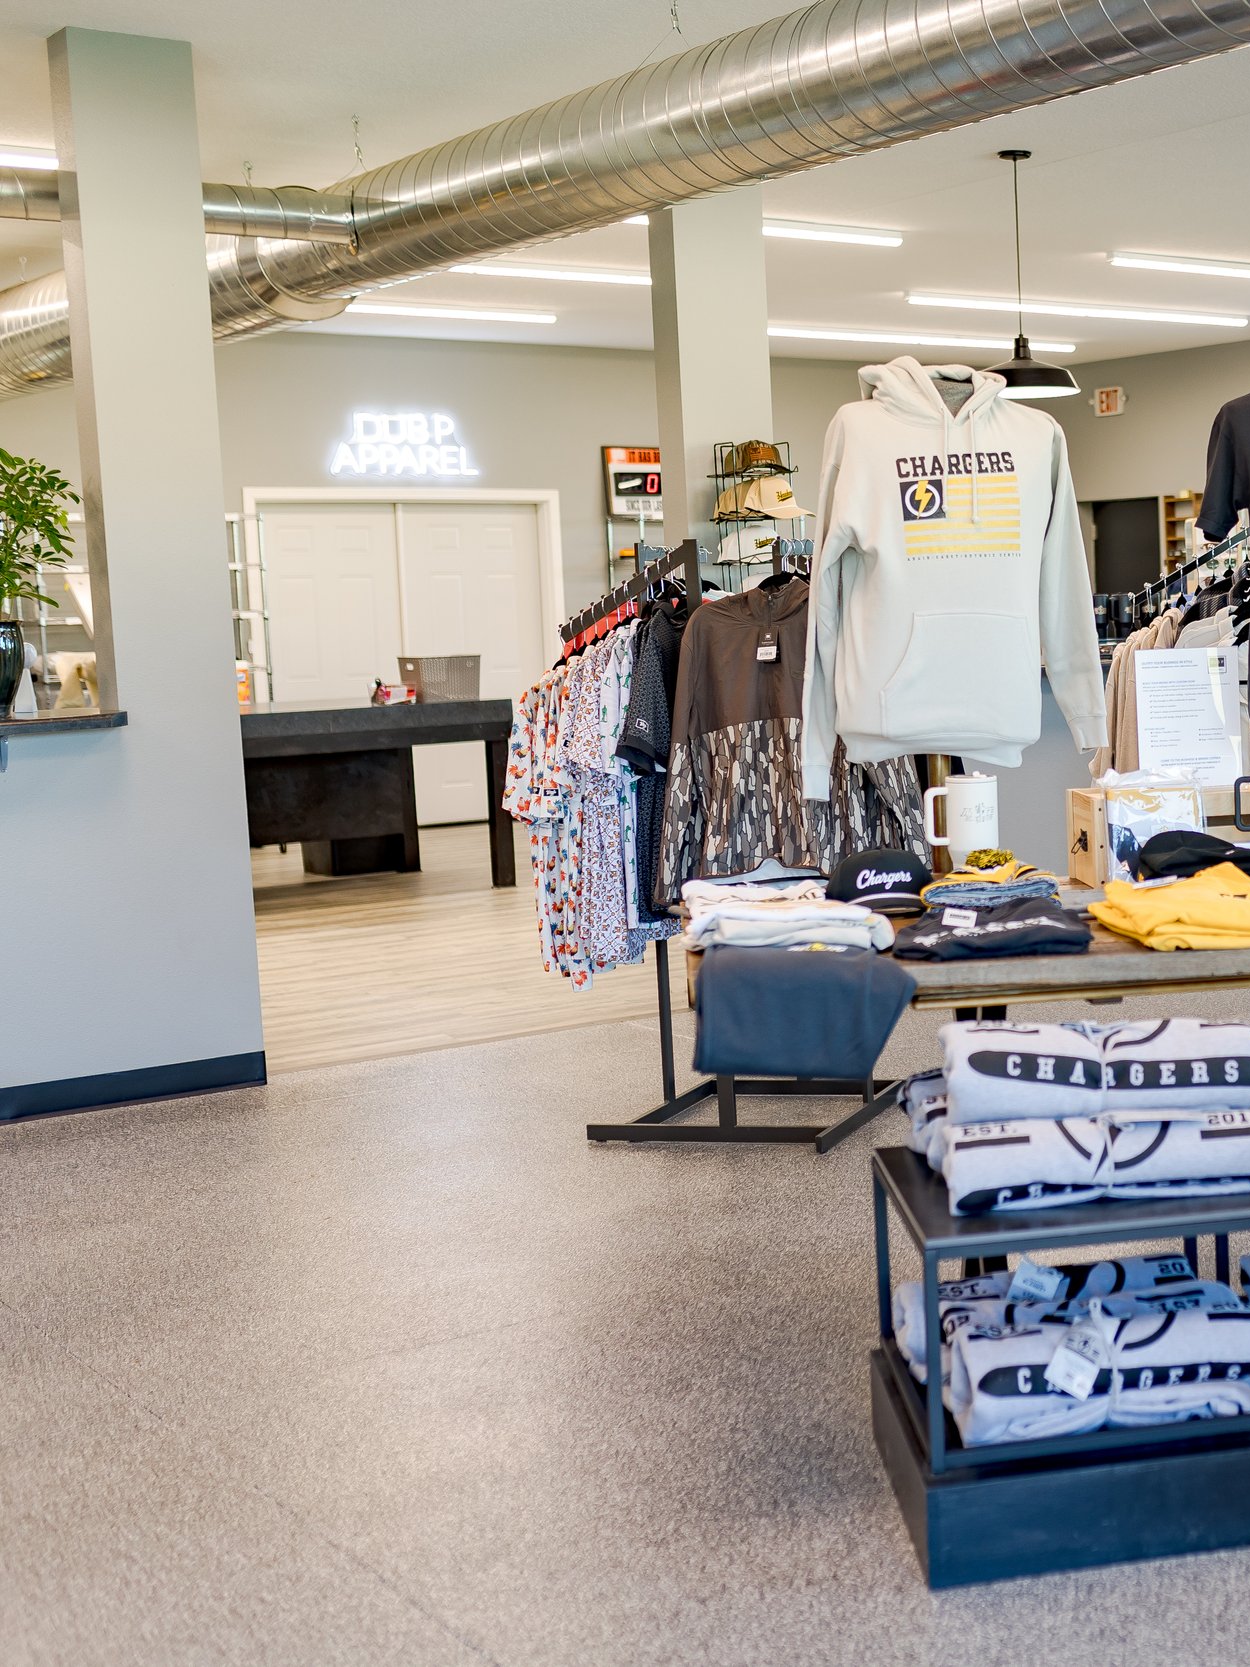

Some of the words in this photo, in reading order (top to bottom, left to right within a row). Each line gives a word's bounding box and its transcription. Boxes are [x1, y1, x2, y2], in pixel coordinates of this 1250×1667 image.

[354, 412, 429, 444] DUB
[433, 413, 455, 444] P
[330, 442, 479, 475] APPAREL
[896, 452, 1015, 478] CHARGERS
[647, 474, 659, 494] 0
[856, 868, 912, 890] Chargers
